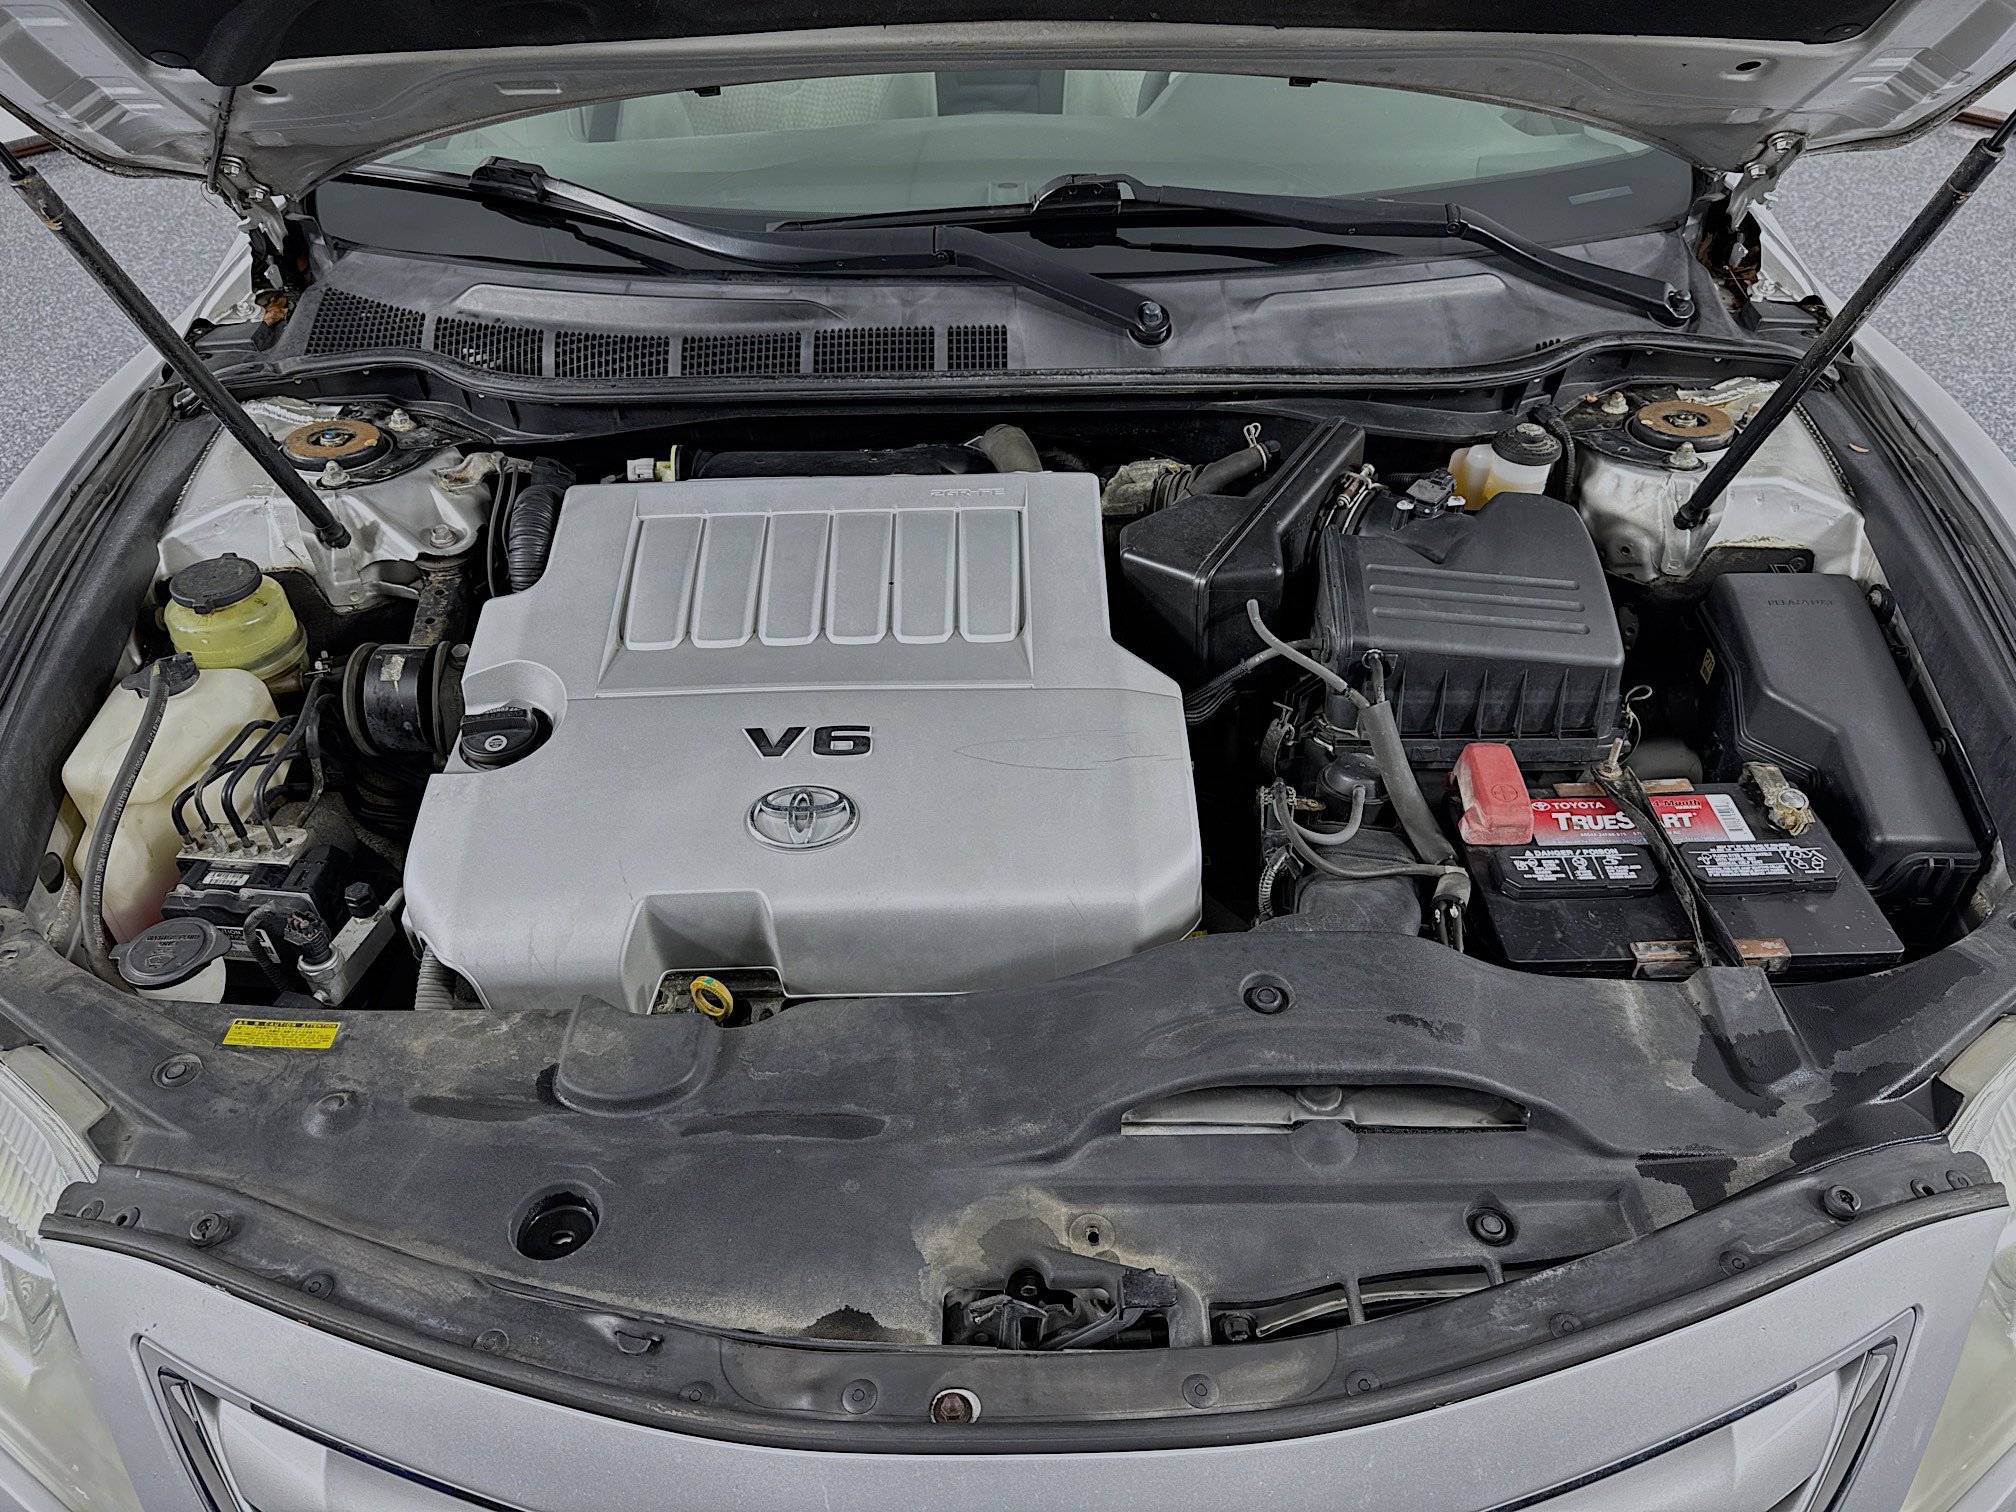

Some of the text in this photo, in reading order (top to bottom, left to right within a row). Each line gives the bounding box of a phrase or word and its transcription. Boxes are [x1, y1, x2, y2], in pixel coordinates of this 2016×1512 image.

[930, 487, 1006, 497] 2GR-FE
[742, 724, 873, 759] V6
[1551, 801, 1606, 810] TOYOTA
[1653, 799, 1702, 807] 4-Month
[1551, 811, 1694, 831] TRUESRT
